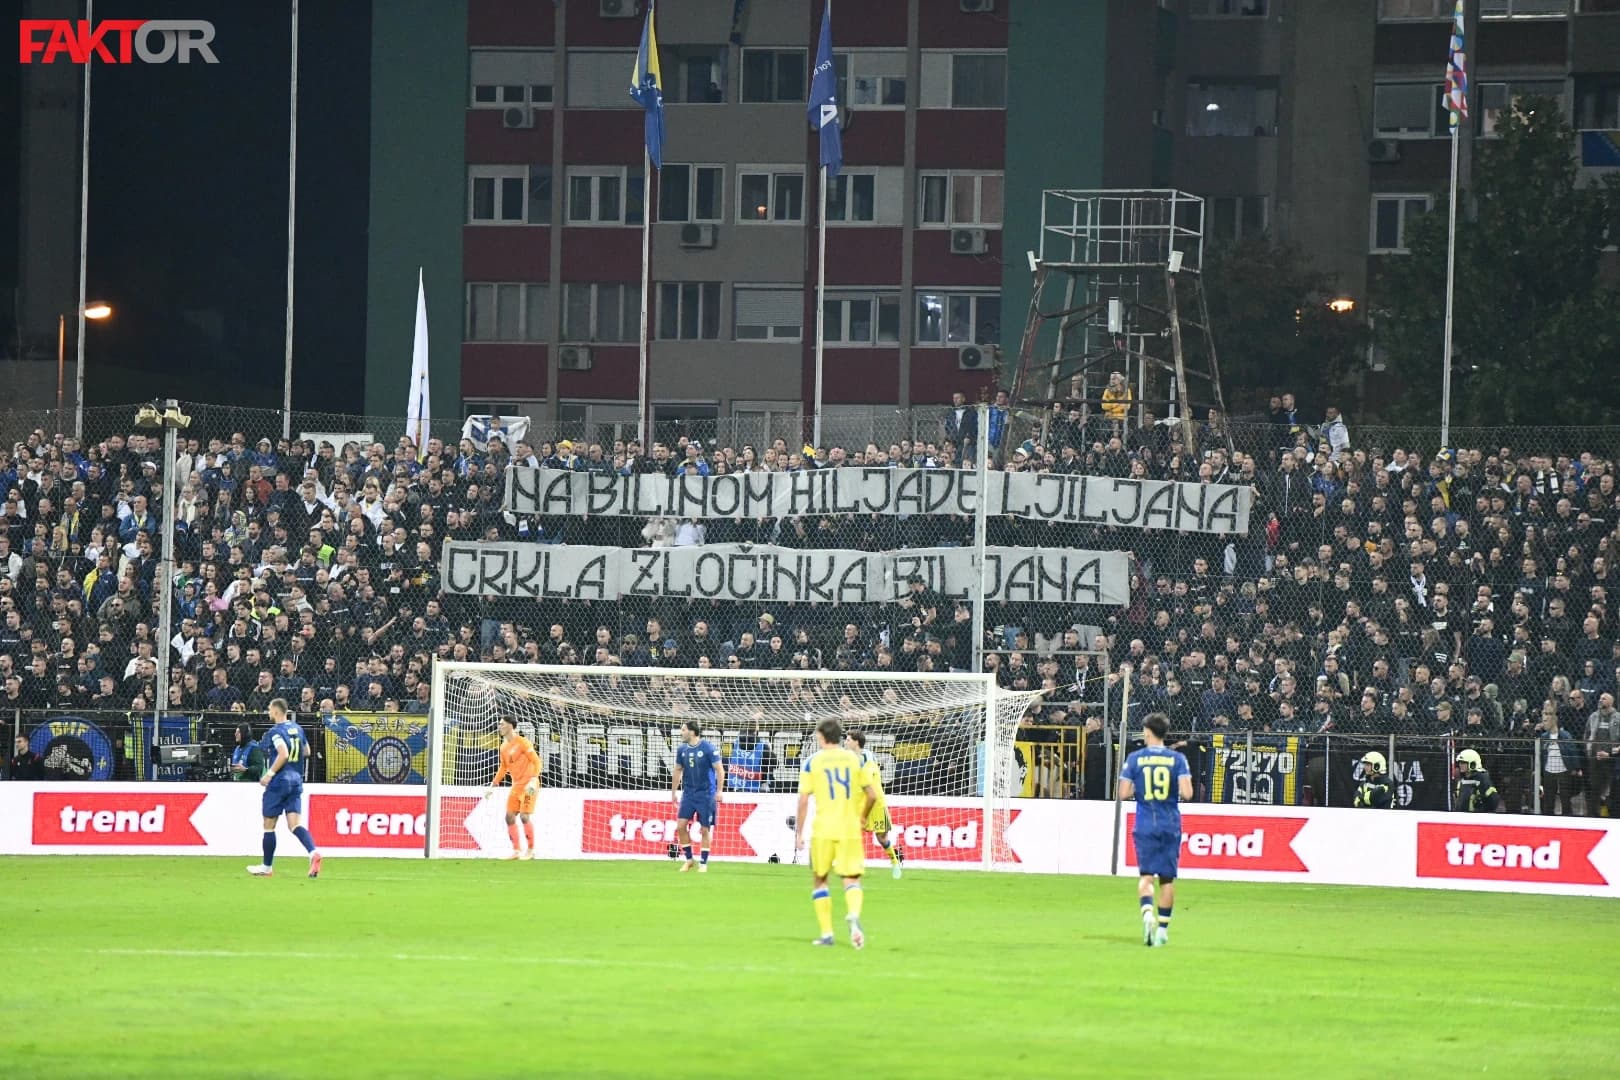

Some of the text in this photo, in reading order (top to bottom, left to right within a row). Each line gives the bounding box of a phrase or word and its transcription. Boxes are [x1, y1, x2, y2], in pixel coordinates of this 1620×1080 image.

[512, 468, 1239, 531] NA BILINOM HILJADE LJILJANA
[448, 545, 1100, 601] CRKLA ZLOČINKA BILJANA
[288, 737, 300, 762] 11
[823, 767, 850, 800] 14
[1142, 766, 1170, 800] 19
[60, 804, 165, 833] trend
[873, 821, 884, 830] 22
[1445, 837, 1561, 869] trend
